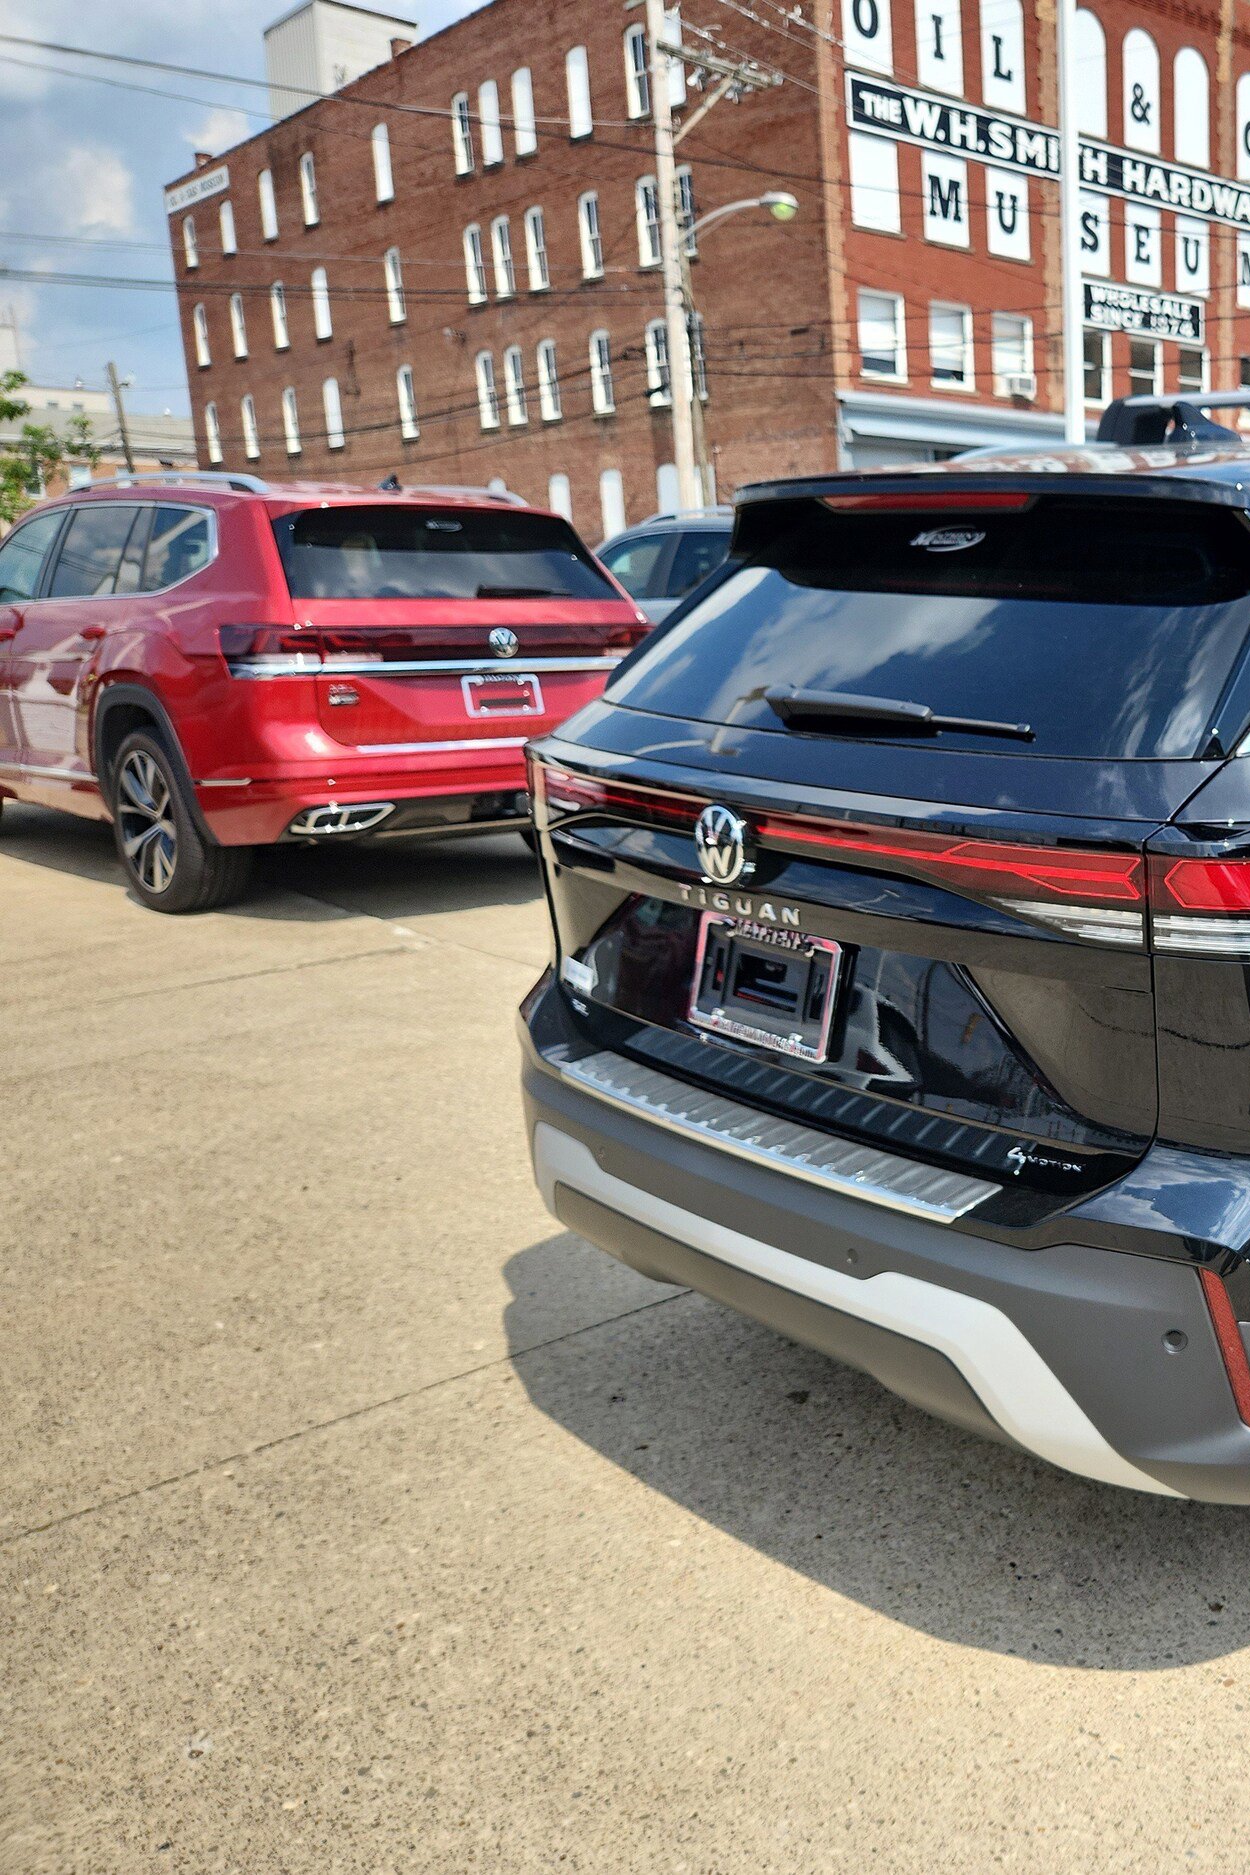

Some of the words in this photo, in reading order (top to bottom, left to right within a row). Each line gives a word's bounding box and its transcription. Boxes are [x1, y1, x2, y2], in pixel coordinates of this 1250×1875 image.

[859, 90, 902, 124] THE
[1090, 286, 1192, 320] WHOLESALE
[1090, 303, 1144, 328] SINCE
[678, 883, 800, 926] TIGUAN
